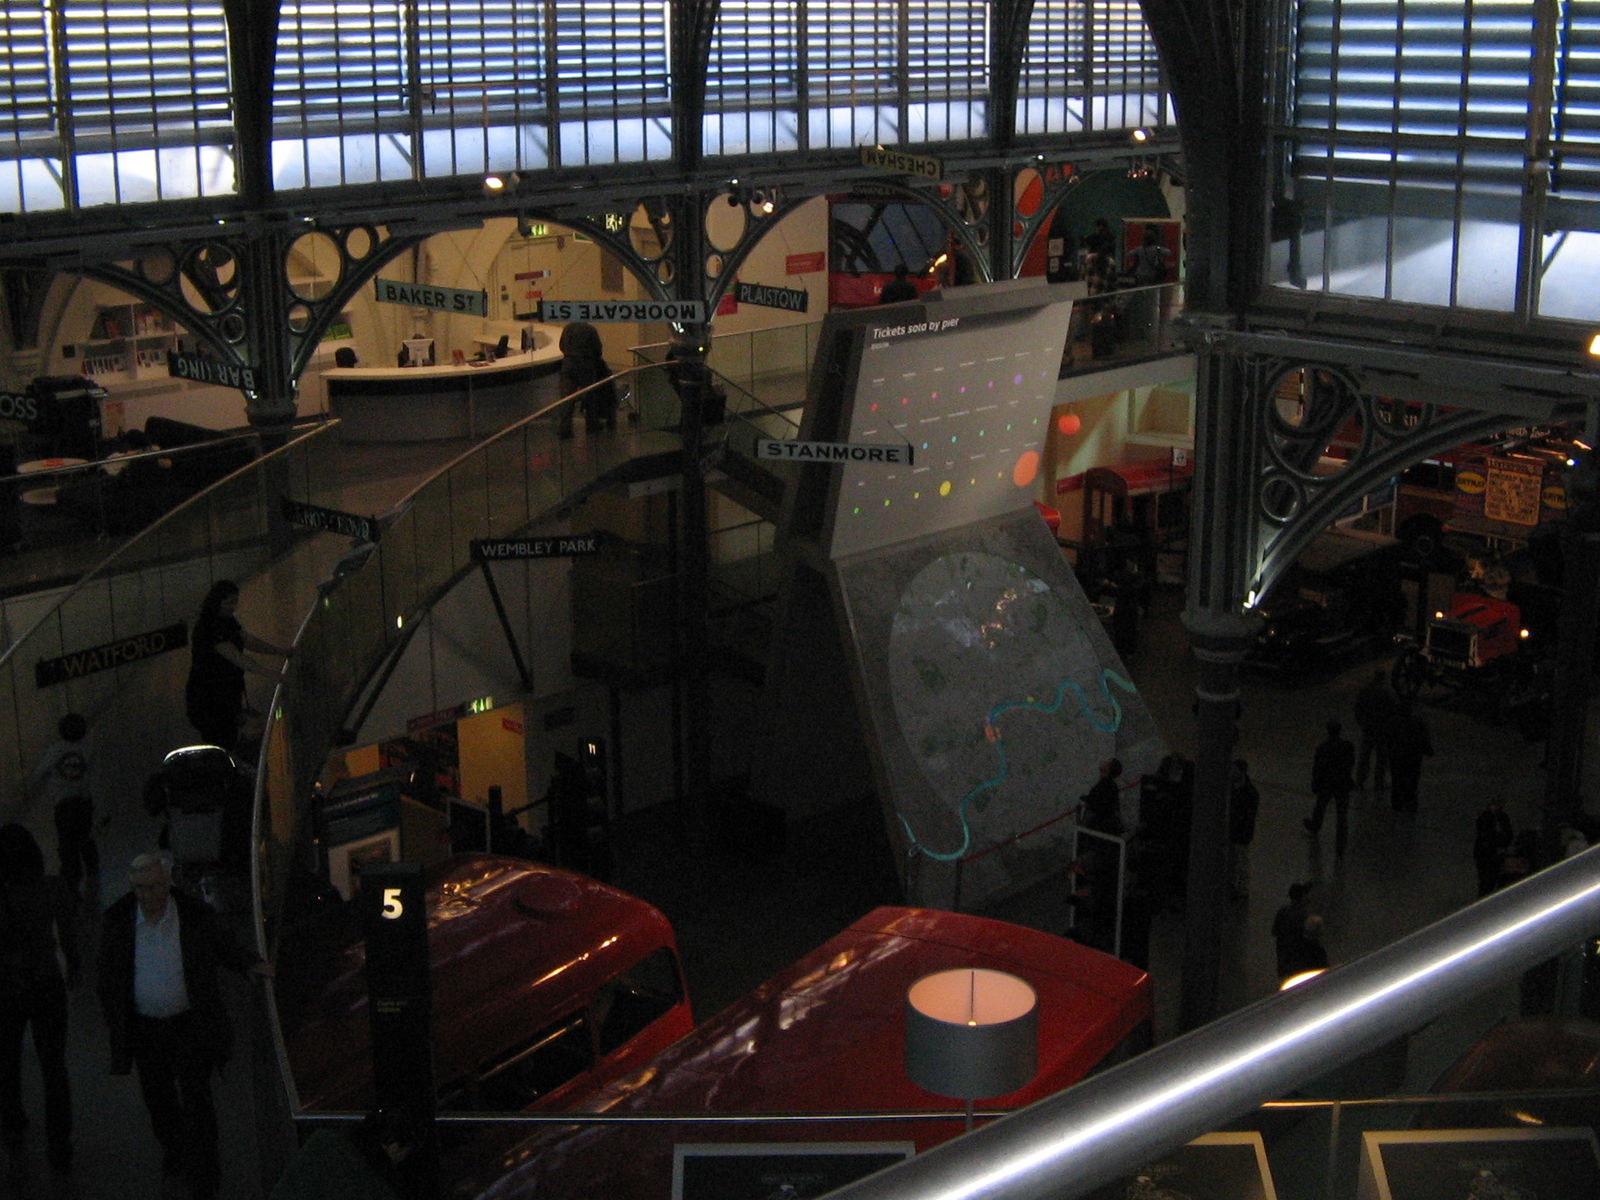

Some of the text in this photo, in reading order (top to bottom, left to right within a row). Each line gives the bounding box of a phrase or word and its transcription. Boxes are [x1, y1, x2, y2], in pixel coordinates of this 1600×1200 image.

[867, 150, 937, 177] CHESHAM
[386, 284, 446, 308] BAKER
[741, 285, 802, 309] PLAISTOW
[578, 304, 696, 320] MOORGATE
[873, 318, 960, 340] Tickets sold by pier
[767, 443, 899, 463] STANMORE
[481, 538, 597, 558] WEMBLEY PARK
[63, 631, 168, 678] WATFORD
[381, 888, 404, 920] 5
